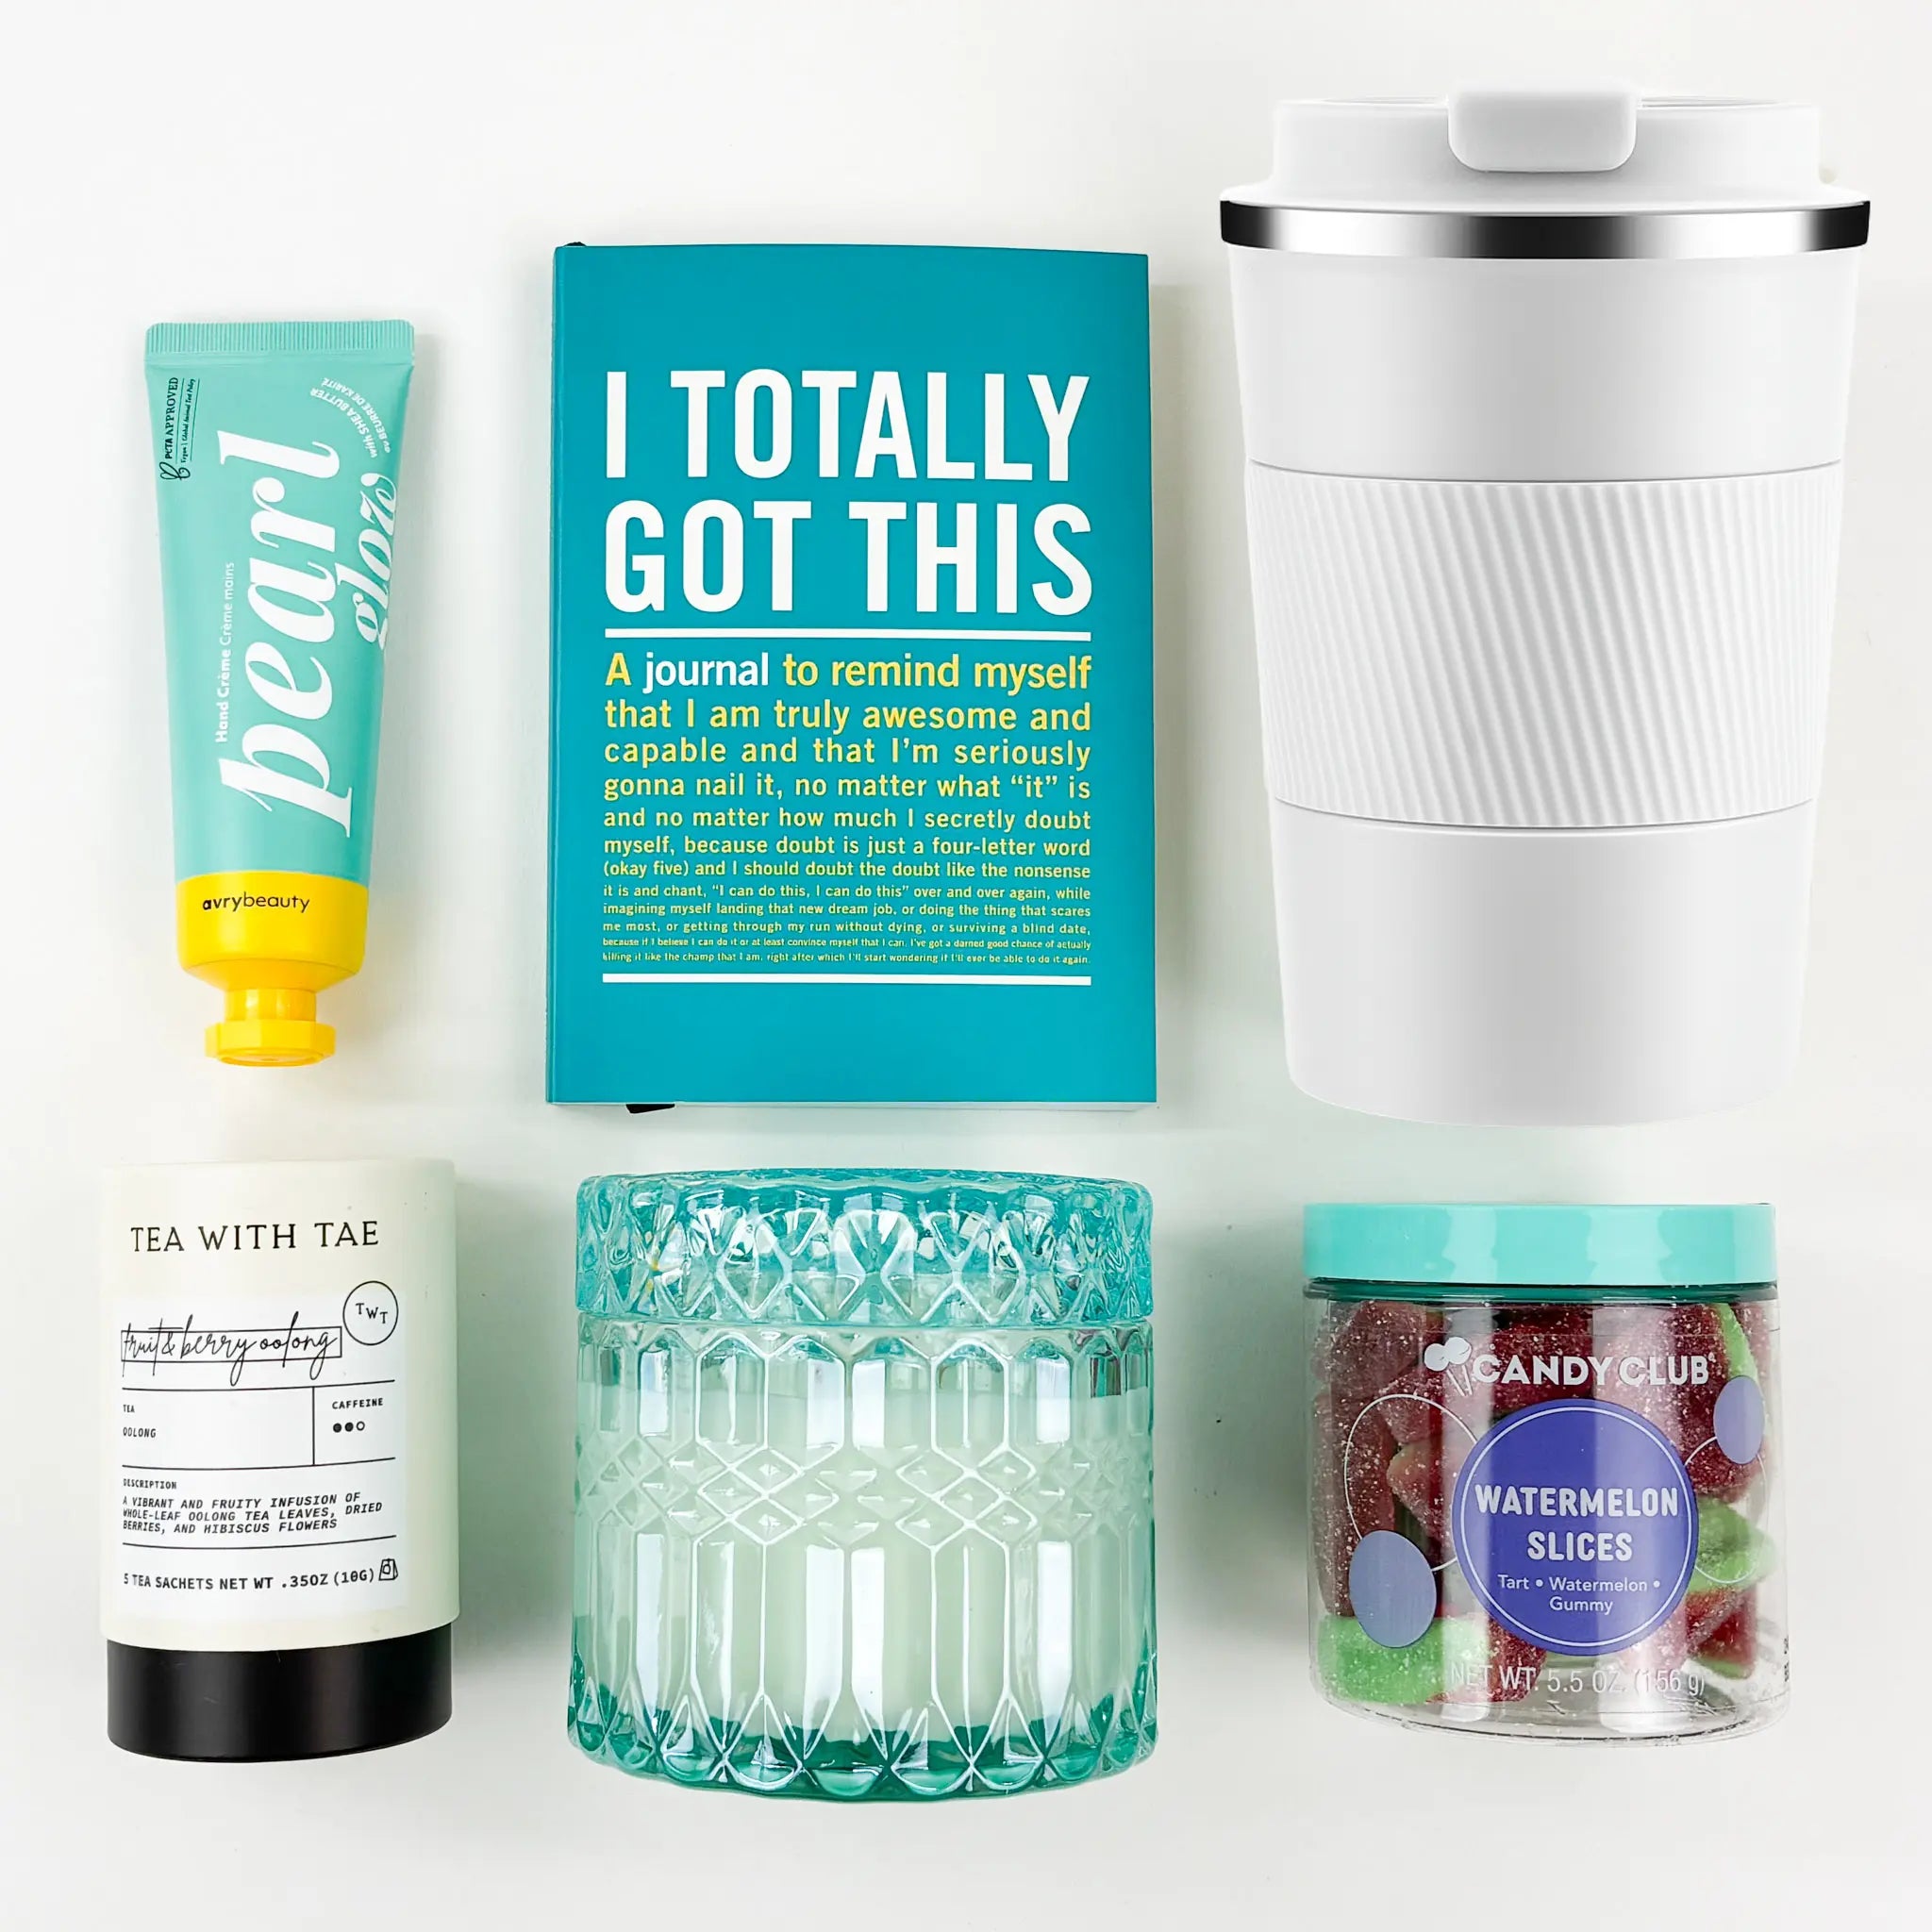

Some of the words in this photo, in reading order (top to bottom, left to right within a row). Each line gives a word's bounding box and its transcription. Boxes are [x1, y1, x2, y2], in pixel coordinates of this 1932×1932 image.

[165, 376, 179, 436] APPROVED
[310, 388, 350, 411] BUTTER
[346, 408, 370, 435] SHEA
[607, 372, 626, 477] I
[671, 369, 1089, 481] TOTALLY
[606, 500, 811, 612] GOT
[849, 502, 1091, 615] THIS
[224, 561, 235, 600] mains
[216, 429, 354, 839] pearl
[219, 603, 234, 646] Crème
[216, 648, 232, 699] Crème
[606, 653, 631, 685] A
[642, 652, 768, 693] journal
[783, 654, 818, 686] to
[833, 653, 958, 687] remind
[975, 656, 1091, 696] myself
[214, 700, 229, 743] Hand
[605, 699, 671, 727] that
[687, 699, 694, 726] I
[710, 707, 758, 727] am
[774, 699, 849, 735] truly
[863, 707, 1016, 729] awesome
[1030, 703, 1090, 730] and
[605, 737, 725, 768] capable
[741, 738, 796, 762] and
[813, 738, 874, 762] that
[892, 738, 938, 763] I'm
[955, 739, 1090, 771] seriously
[605, 779, 684, 801] gonna
[697, 773, 743, 795] nail
[758, 773, 783, 799] it,
[796, 779, 826, 795] no
[839, 774, 926, 796] matter
[937, 774, 1000, 797] what
[1011, 775, 1057, 797] "it"
[1070, 775, 1090, 798] is
[604, 808, 644, 826] and
[657, 812, 682, 825] no
[693, 808, 769, 826] matter
[780, 808, 824, 826] how
[835, 808, 895, 826] much
[908, 808, 913, 826] I
[925, 809, 1015, 832] secretly
[1025, 810, 1091, 829] doubt
[605, 836, 675, 857] myself,
[685, 836, 767, 853] because
[776, 836, 834, 853] doubt
[844, 836, 858, 853] is
[867, 836, 905, 858] just
[913, 841, 924, 854] a
[933, 837, 1035, 855] four-letter
[1043, 840, 1090, 856] word
[604, 860, 647, 878] (okay
[654, 860, 689, 875] five)
[695, 860, 724, 874] and
[732, 860, 738, 874] I
[744, 861, 798, 874] should
[806, 861, 854, 875] doubt
[859, 861, 886, 875] the
[892, 862, 940, 876] doubt
[947, 862, 974, 876] like
[982, 862, 1008, 876] the
[1015, 867, 1091, 878] nonsense
[202, 891, 310, 914] avrybeauty
[603, 884, 613, 897] it
[618, 884, 629, 897] is
[633, 884, 659, 897] and
[728, 887, 755, 897] can
[758, 884, 775, 897] do
[816, 884, 820, 897] I
[824, 887, 850, 897] can
[855, 885, 873, 897] do
[913, 888, 942, 898] over
[946, 886, 973, 898] and
[976, 888, 1006, 899] over
[1055, 887, 1091, 900] while
[603, 902, 666, 917] imagining
[670, 902, 712, 916] myself
[716, 902, 764, 917] landing
[768, 902, 794, 914] that
[798, 905, 824, 914] new
[827, 903, 869, 914] dream
[901, 906, 915, 915] or
[919, 904, 955, 918] doing
[958, 904, 979, 916] the
[983, 904, 1017, 919] thing
[1021, 904, 1047, 916] that
[1050, 908, 1091, 917] scares
[683, 921, 728, 934] getting
[732, 921, 782, 934] through
[835, 921, 884, 932] without
[949, 922, 1007, 936] surviving
[131, 1227, 184, 1251] TEA
[198, 1224, 295, 1250] WITH
[314, 1221, 378, 1247] TAE
[161, 1331, 176, 1357] &
[179, 1314, 258, 1387] berry
[258, 1311, 339, 1380] oolong
[1472, 1355, 1615, 1386] CANDY
[1619, 1356, 1709, 1386] CLUB
[123, 1404, 135, 1413] TEA
[332, 1398, 383, 1409] CAFFEINE
[123, 1426, 157, 1439] OOLONG
[123, 1478, 177, 1490] DESCRIPTION
[123, 1495, 128, 1507] A
[132, 1496, 175, 1508] VIBRANT
[180, 1499, 204, 1509] AND
[211, 1498, 262, 1509] FRUITY
[270, 1493, 338, 1508] INFUSION
[344, 1491, 361, 1503] OF
[123, 1508, 181, 1522] WHOLE-LEAF
[188, 1511, 236, 1522] OOLONG
[244, 1510, 270, 1522] TEA
[278, 1507, 337, 1522] LEAVES,
[344, 1501, 383, 1516] DRIED
[1474, 1484, 1678, 1518] WATERMELON
[123, 1521, 166, 1535] BERRIES,
[173, 1524, 196, 1534] AND
[204, 1523, 270, 1534] HIBISCUS
[278, 1518, 338, 1533] FLOWERS
[1527, 1530, 1634, 1562] SLICES
[123, 1573, 129, 1586] 5
[132, 1574, 152, 1589] TEA
[155, 1576, 213, 1591] SACHETS
[219, 1577, 248, 1591] NET
[253, 1576, 274, 1590] WT
[333, 1568, 375, 1587] (10G)
[1498, 1574, 1529, 1590] Tart
[1548, 1576, 1648, 1591] Watermelon
[1549, 1596, 1613, 1615] Gummy
[1451, 1663, 1493, 1687] NET
[1500, 1666, 1540, 1691] WT.
[1547, 1668, 1584, 1693] 5.5
[1634, 1668, 1682, 1694] (156
[1688, 1674, 1706, 1696] g)
